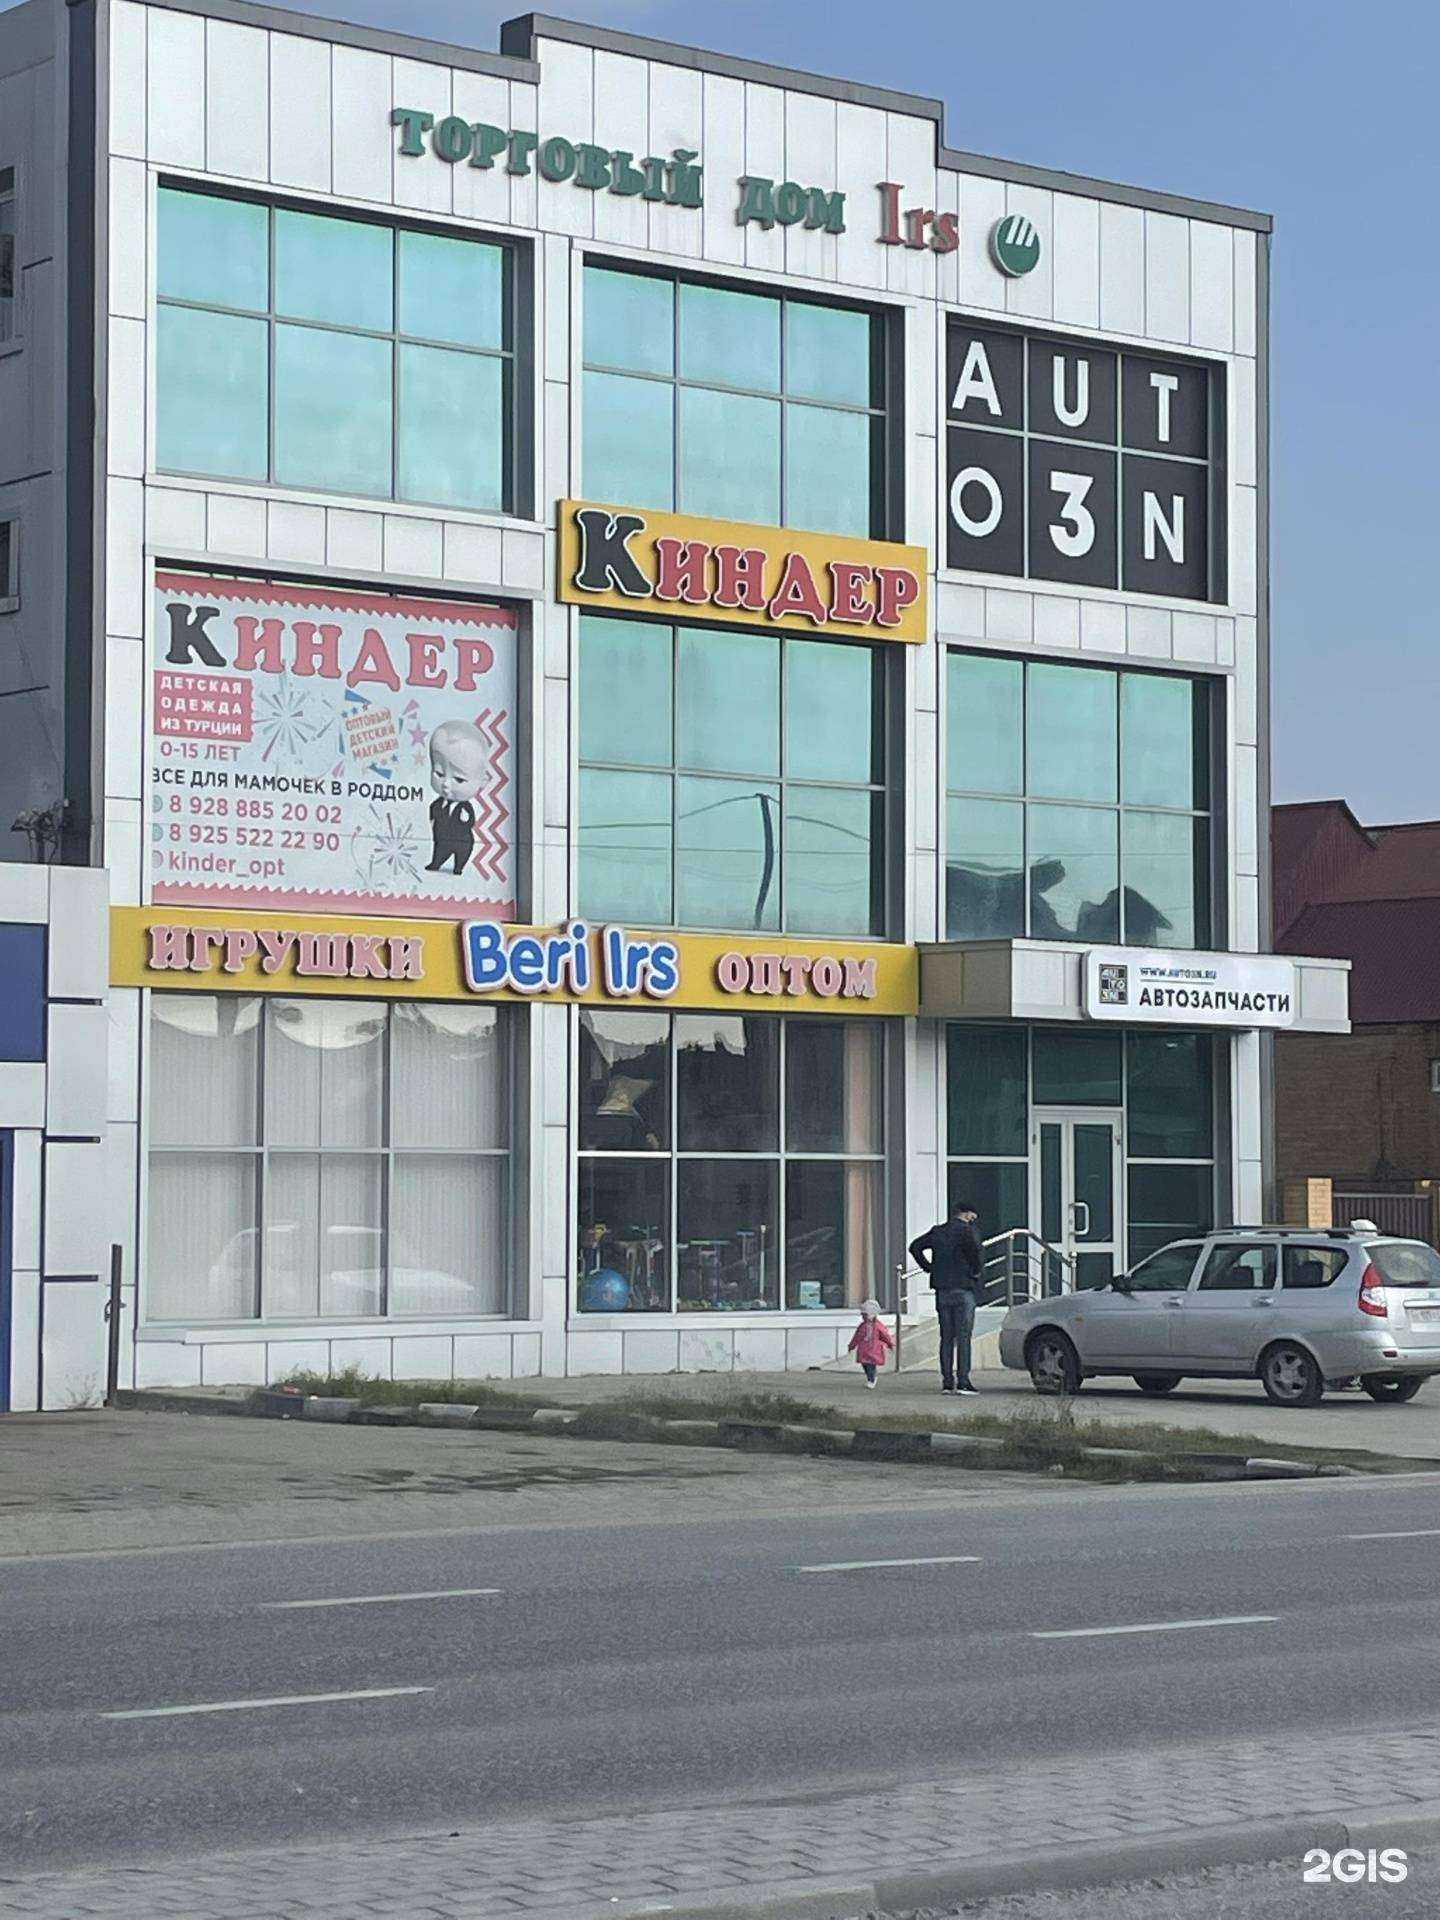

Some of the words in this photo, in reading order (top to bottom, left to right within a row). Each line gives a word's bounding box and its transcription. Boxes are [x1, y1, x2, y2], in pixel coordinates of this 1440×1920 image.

[392, 107, 703, 208] ТОРГОВЫЙ
[735, 175, 846, 233] ДОМ
[876, 181, 960, 254] Irs
[574, 508, 920, 627] КИНДЕР
[164, 602, 495, 692] КИНДЕР
[160, 675, 242, 695] ДЕТСКАЯ
[160, 696, 242, 715] ОДЕЖДА
[160, 717, 180, 731] ИЗ
[184, 718, 242, 736] ТУРЦИИ
[160, 740, 199, 760] 0-15
[204, 743, 242, 762] ЛЕТ
[190, 770, 229, 789] ДЛЯ
[234, 773, 326, 796] МАМОЧЕК
[331, 780, 343, 796] В
[347, 781, 424, 802] РОДДОМ
[169, 794, 182, 814] 8
[189, 795, 229, 817] 928
[236, 798, 275, 820] 885
[281, 802, 308, 822] 20
[315, 804, 342, 824] 02
[169, 822, 182, 842] 8
[188, 823, 229, 845] 925
[235, 826, 275, 848] 522
[280, 829, 305, 850] 22
[313, 832, 340, 852] 90
[168, 850, 286, 879] kinder_opt
[148, 924, 426, 980] ИГРУШКИ
[463, 918, 591, 994] Beri
[602, 924, 679, 997] Irs
[717, 951, 878, 999] ОПТОМ
[1138, 986, 1291, 1013] АВТОЗАПЧАСТИ
